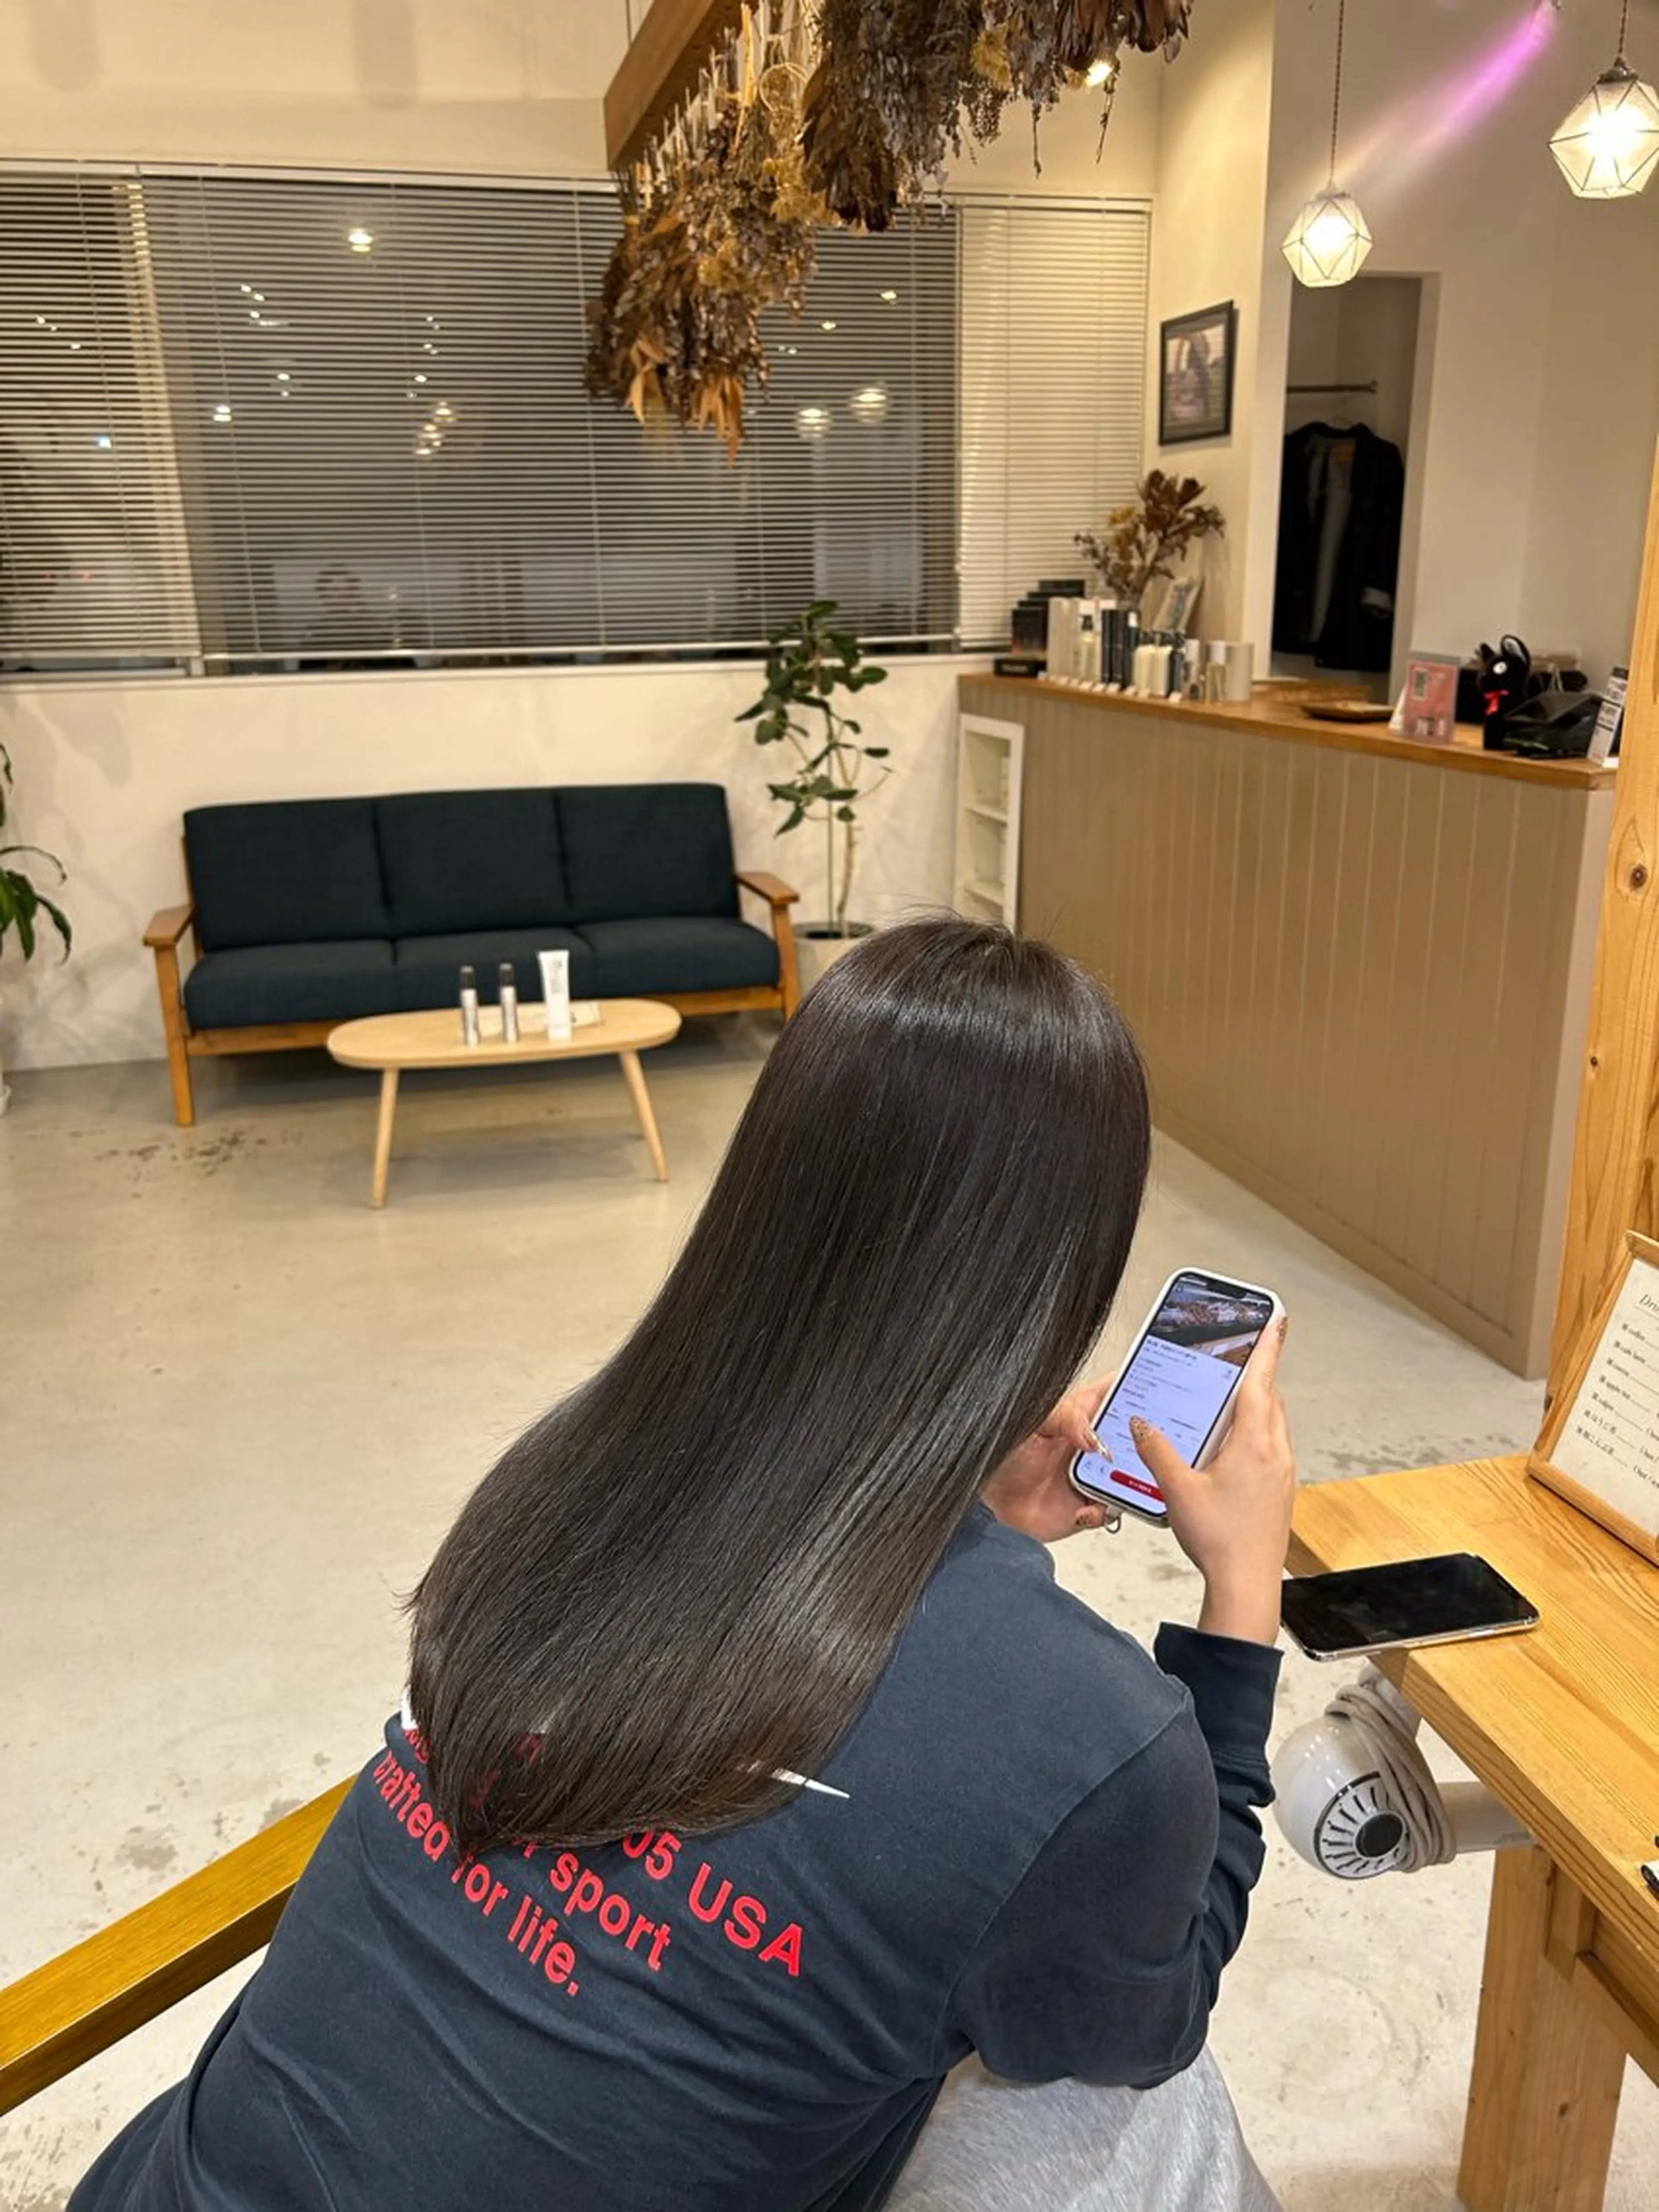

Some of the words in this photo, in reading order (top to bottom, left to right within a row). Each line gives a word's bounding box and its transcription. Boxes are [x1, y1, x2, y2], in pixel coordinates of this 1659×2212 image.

[509, 1896, 578, 1995] life.
[550, 1853, 671, 1971] sport
[689, 1863, 802, 1977] USA
